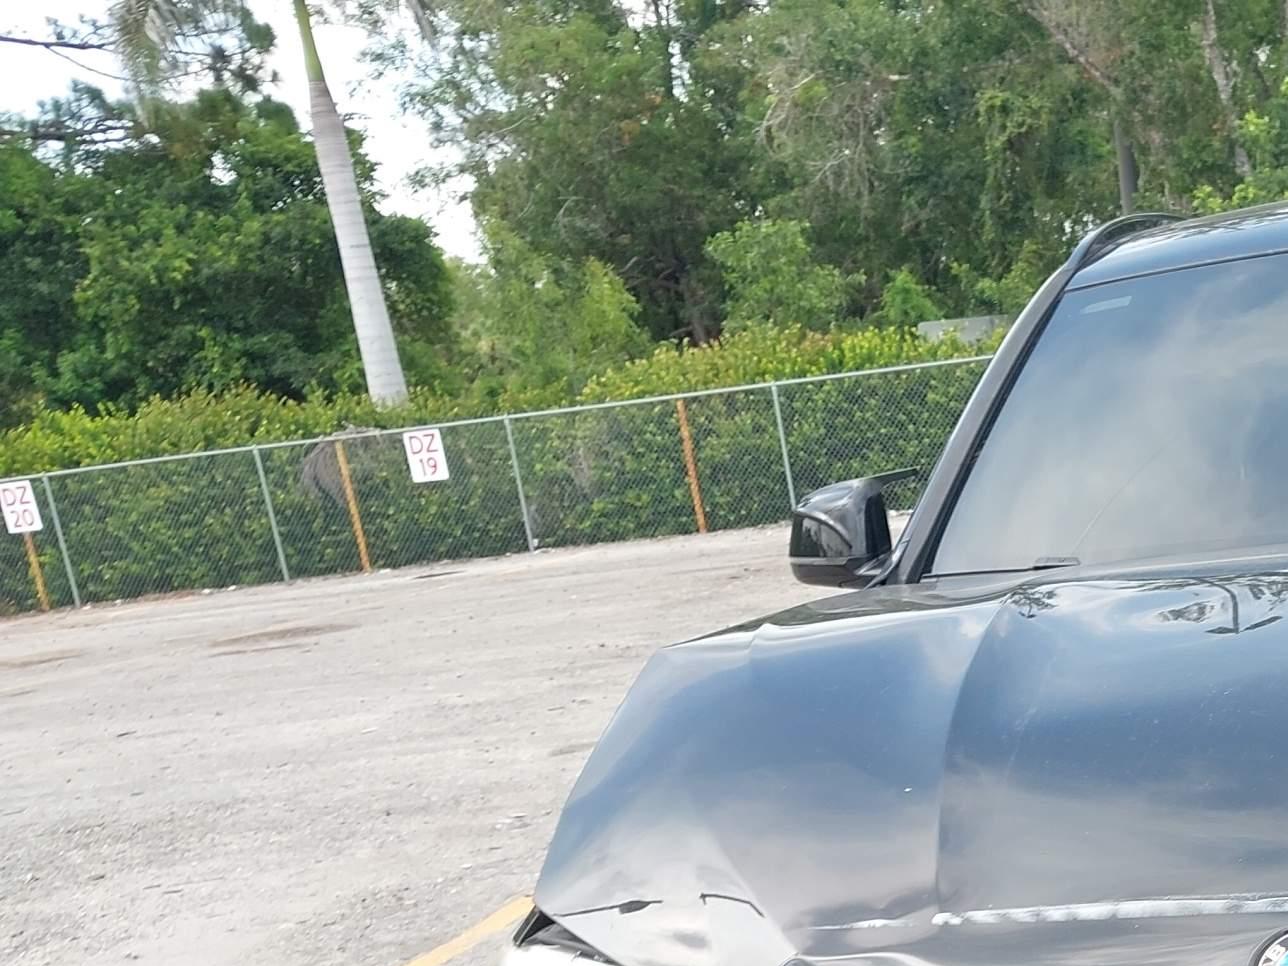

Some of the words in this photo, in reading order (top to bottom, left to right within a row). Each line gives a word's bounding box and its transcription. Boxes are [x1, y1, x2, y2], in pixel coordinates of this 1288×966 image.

[408, 433, 439, 455] DZ
[419, 457, 438, 476] 19
[2, 486, 32, 506] DZ
[9, 509, 35, 528] 20
